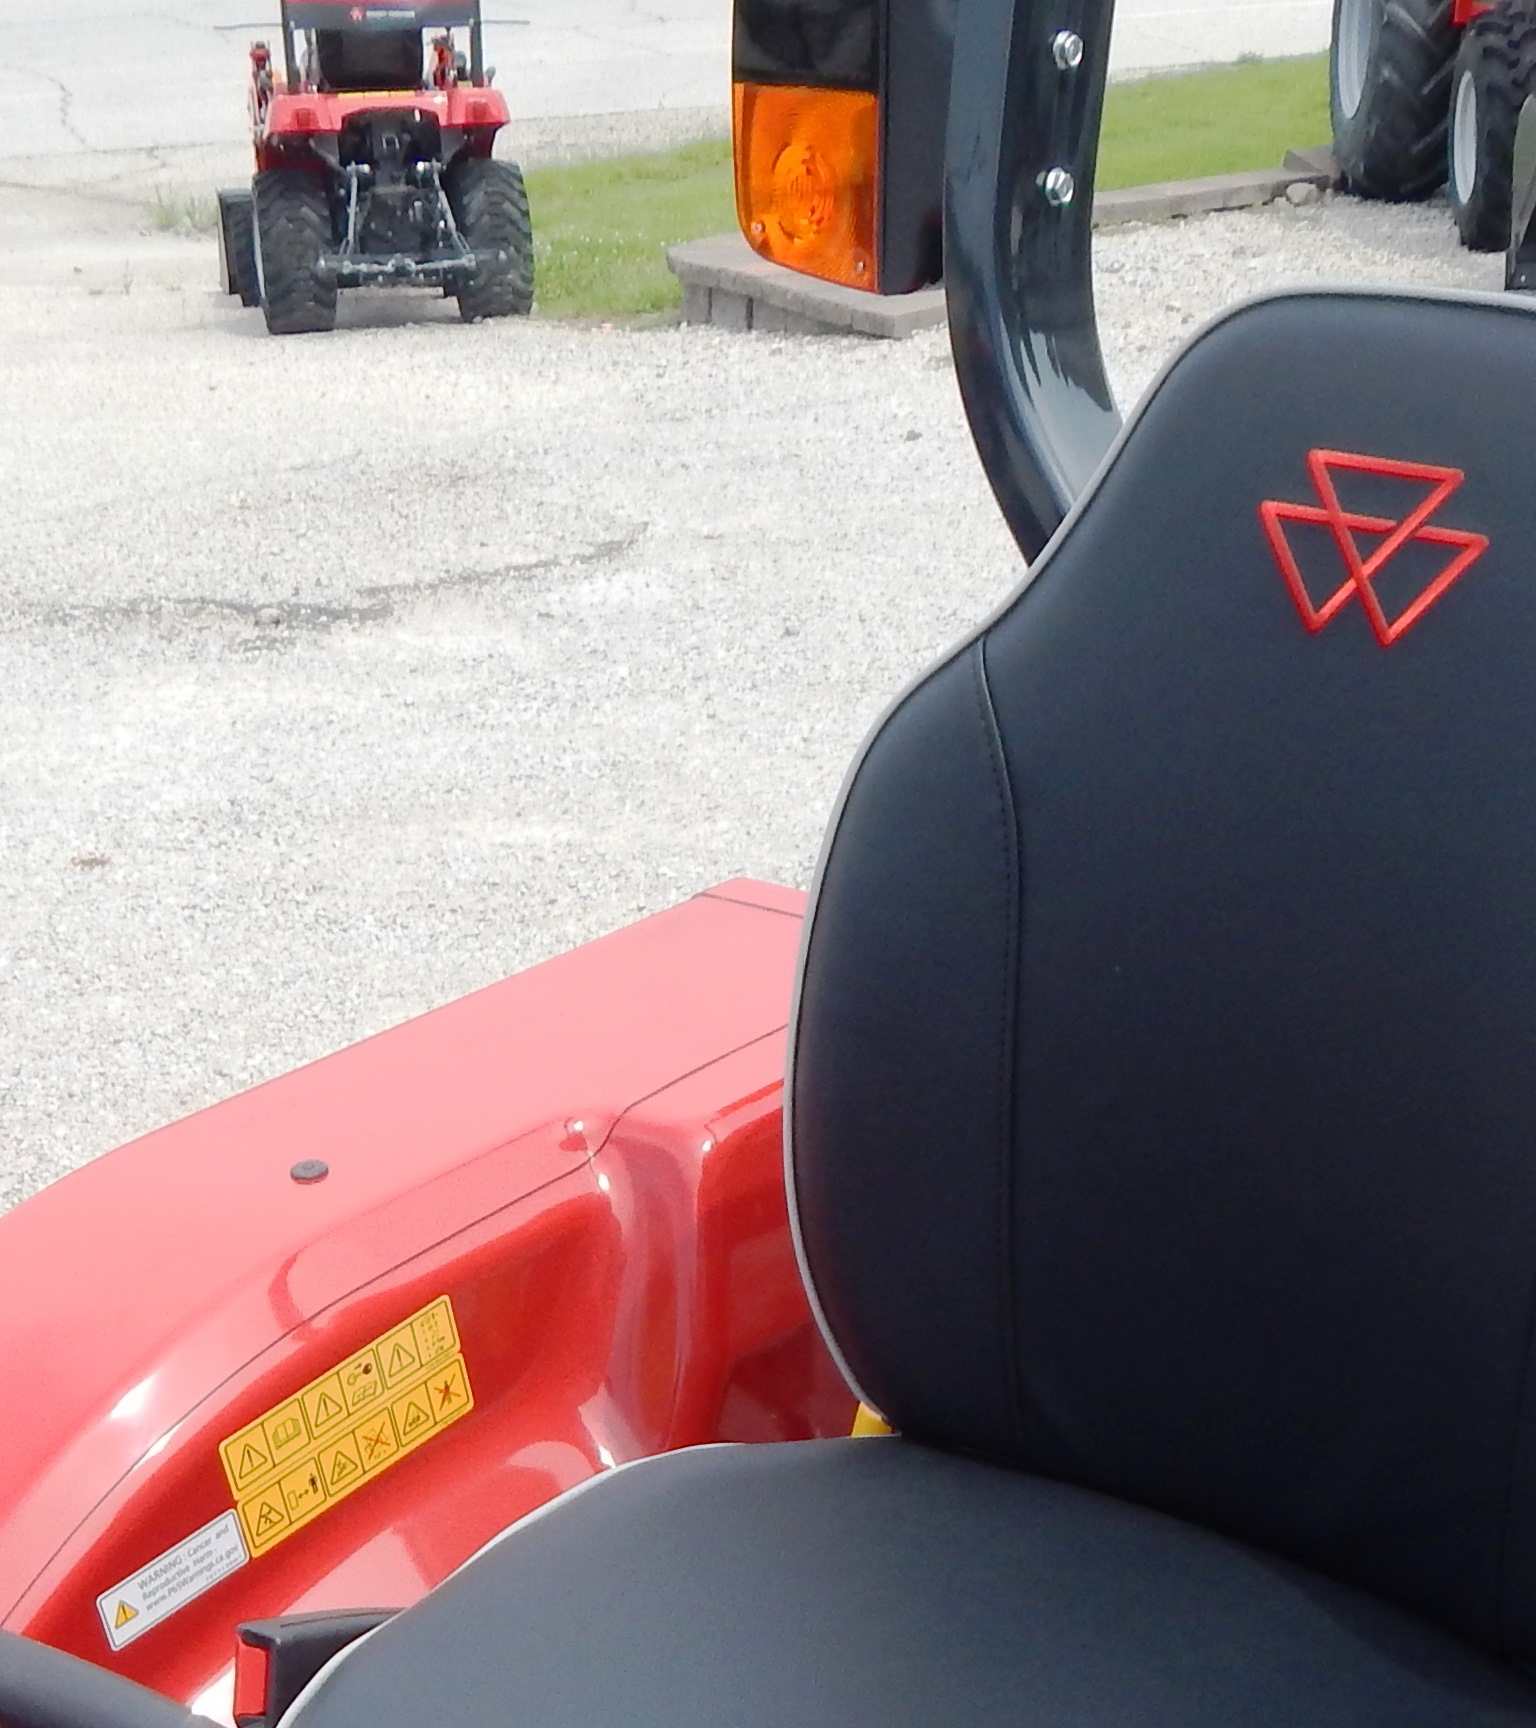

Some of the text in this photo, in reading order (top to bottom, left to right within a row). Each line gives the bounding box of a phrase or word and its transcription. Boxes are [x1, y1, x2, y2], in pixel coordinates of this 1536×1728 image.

[187, 1537, 212, 1558] Cancer
[215, 1524, 230, 1540] and
[142, 1565, 191, 1601] Reproductive
